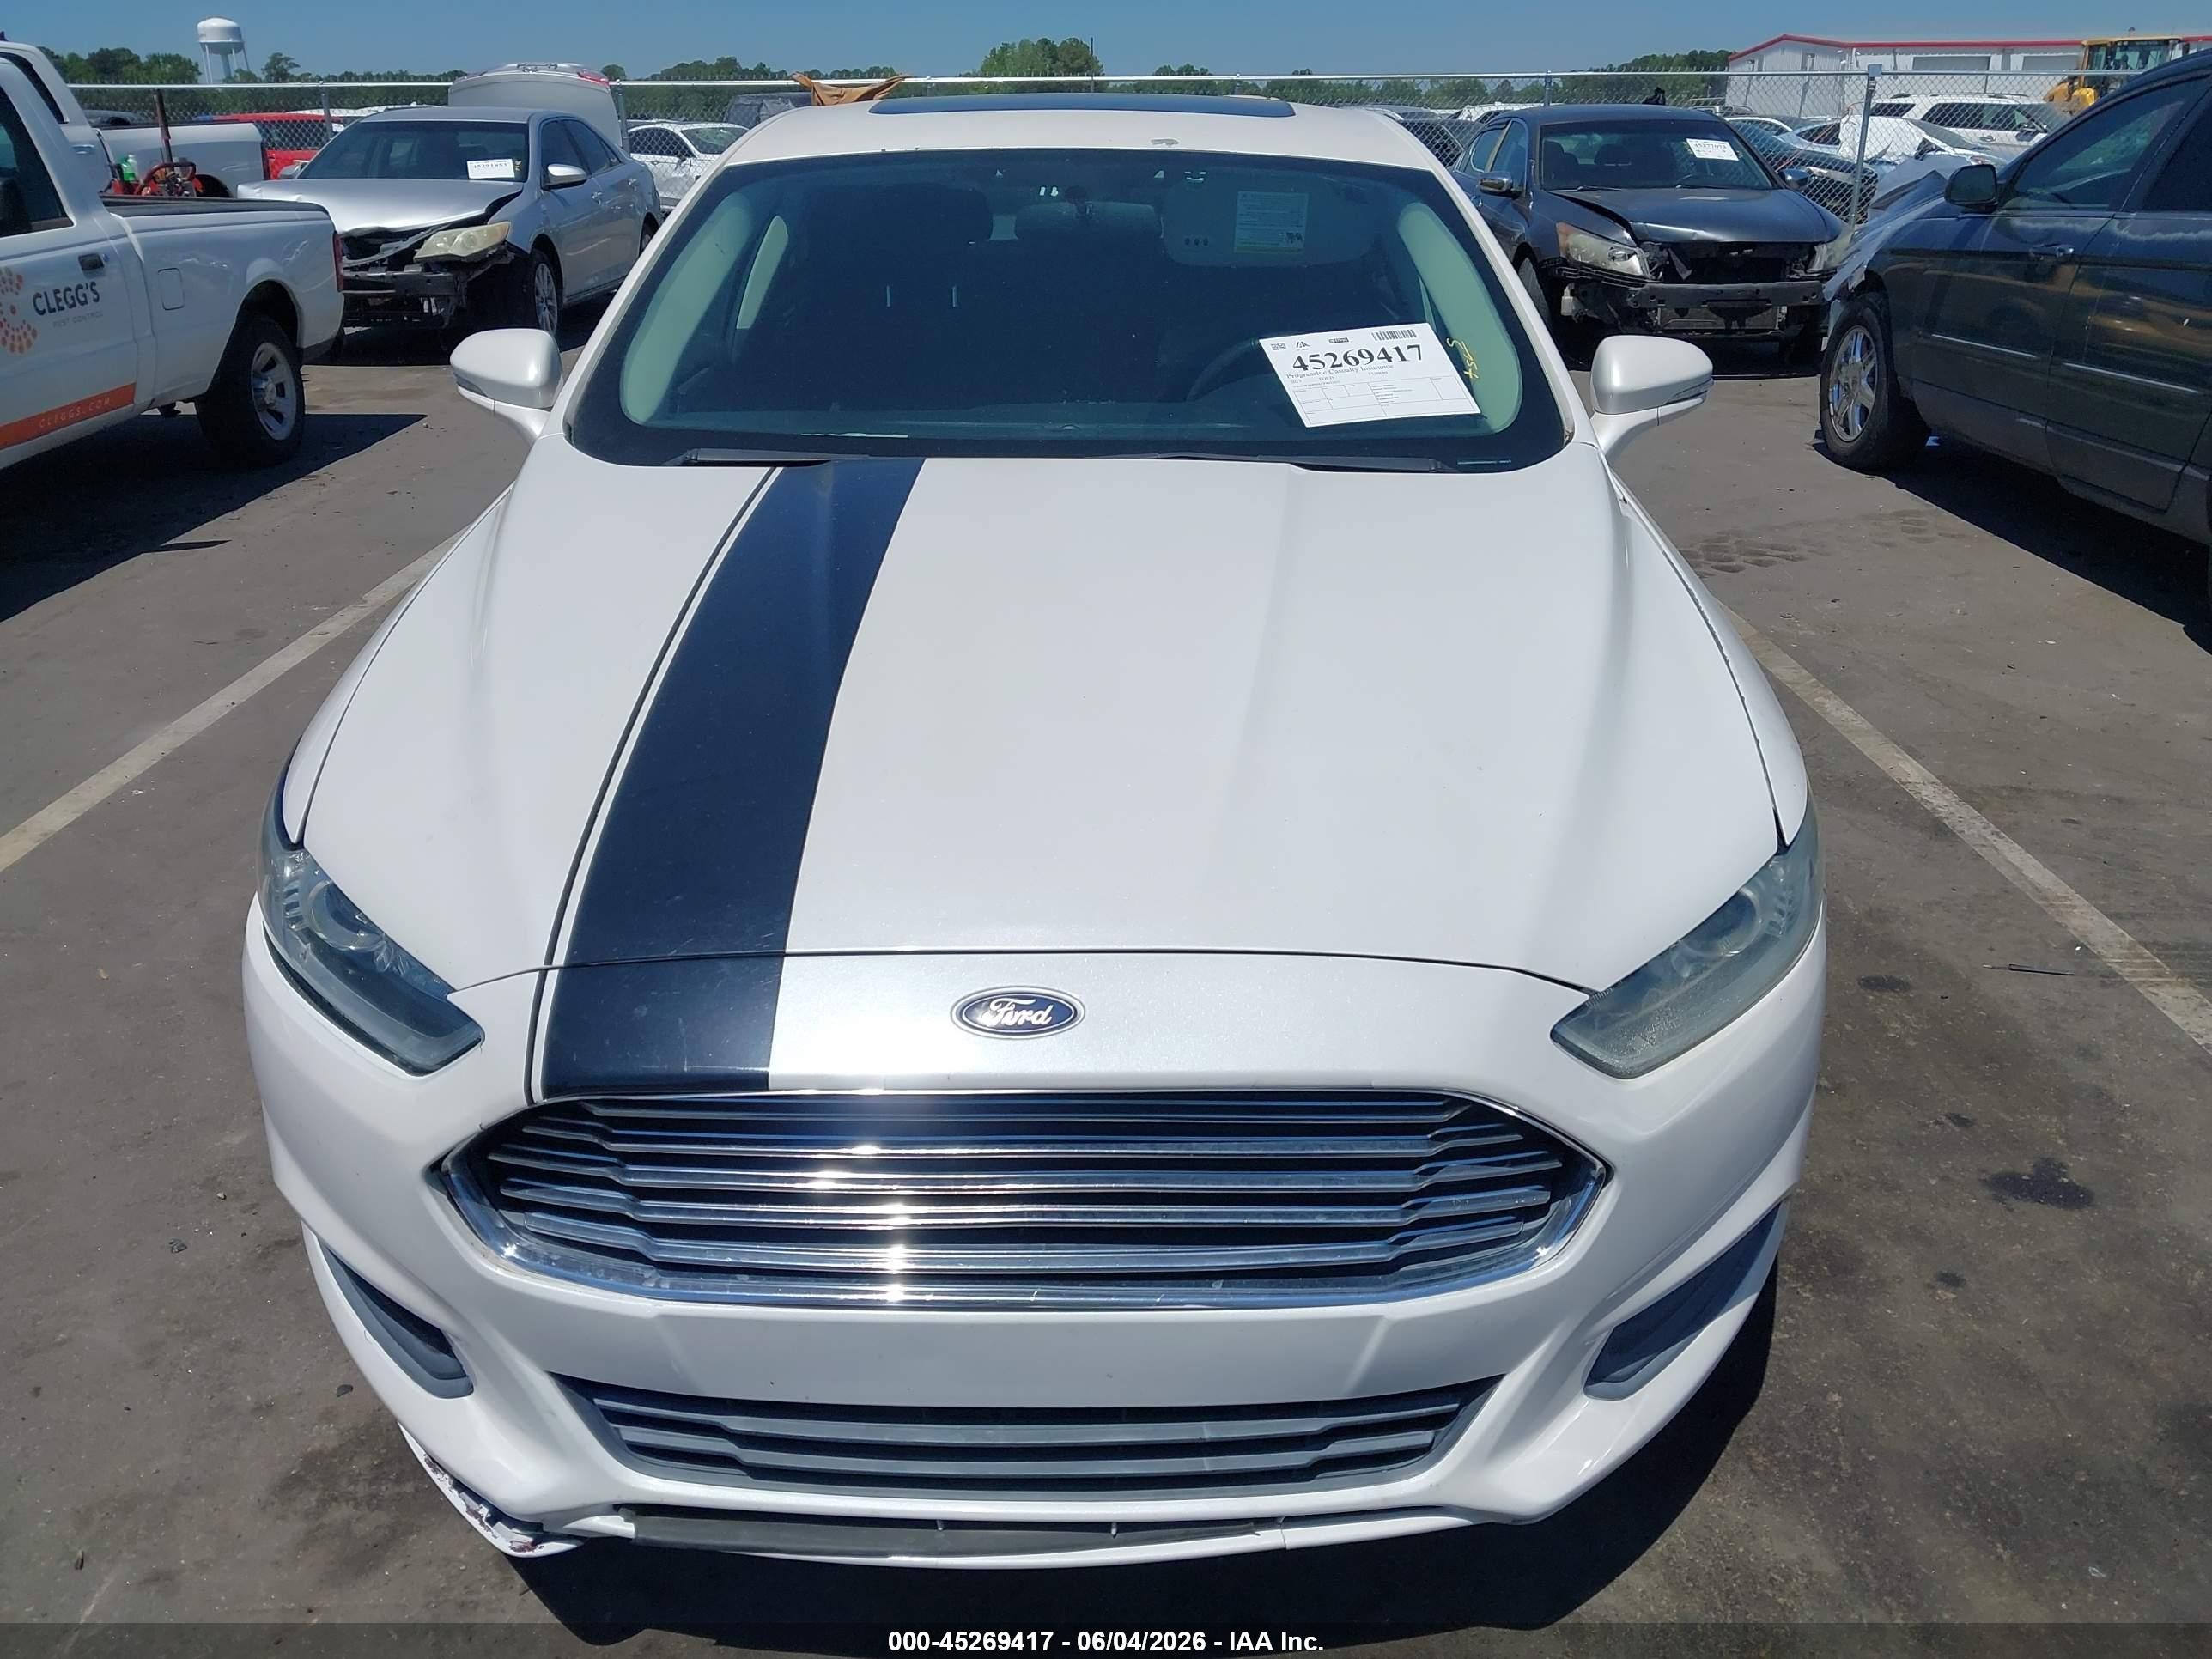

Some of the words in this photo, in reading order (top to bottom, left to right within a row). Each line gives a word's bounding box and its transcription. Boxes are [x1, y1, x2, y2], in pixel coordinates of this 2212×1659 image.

[33, 281, 100, 316] CLEGG'S
[1292, 344, 1422, 371] 45269417
[1286, 369, 1328, 379] Progressive
[1328, 366, 1358, 375] Casualty
[980, 997, 1054, 1026] Ford
